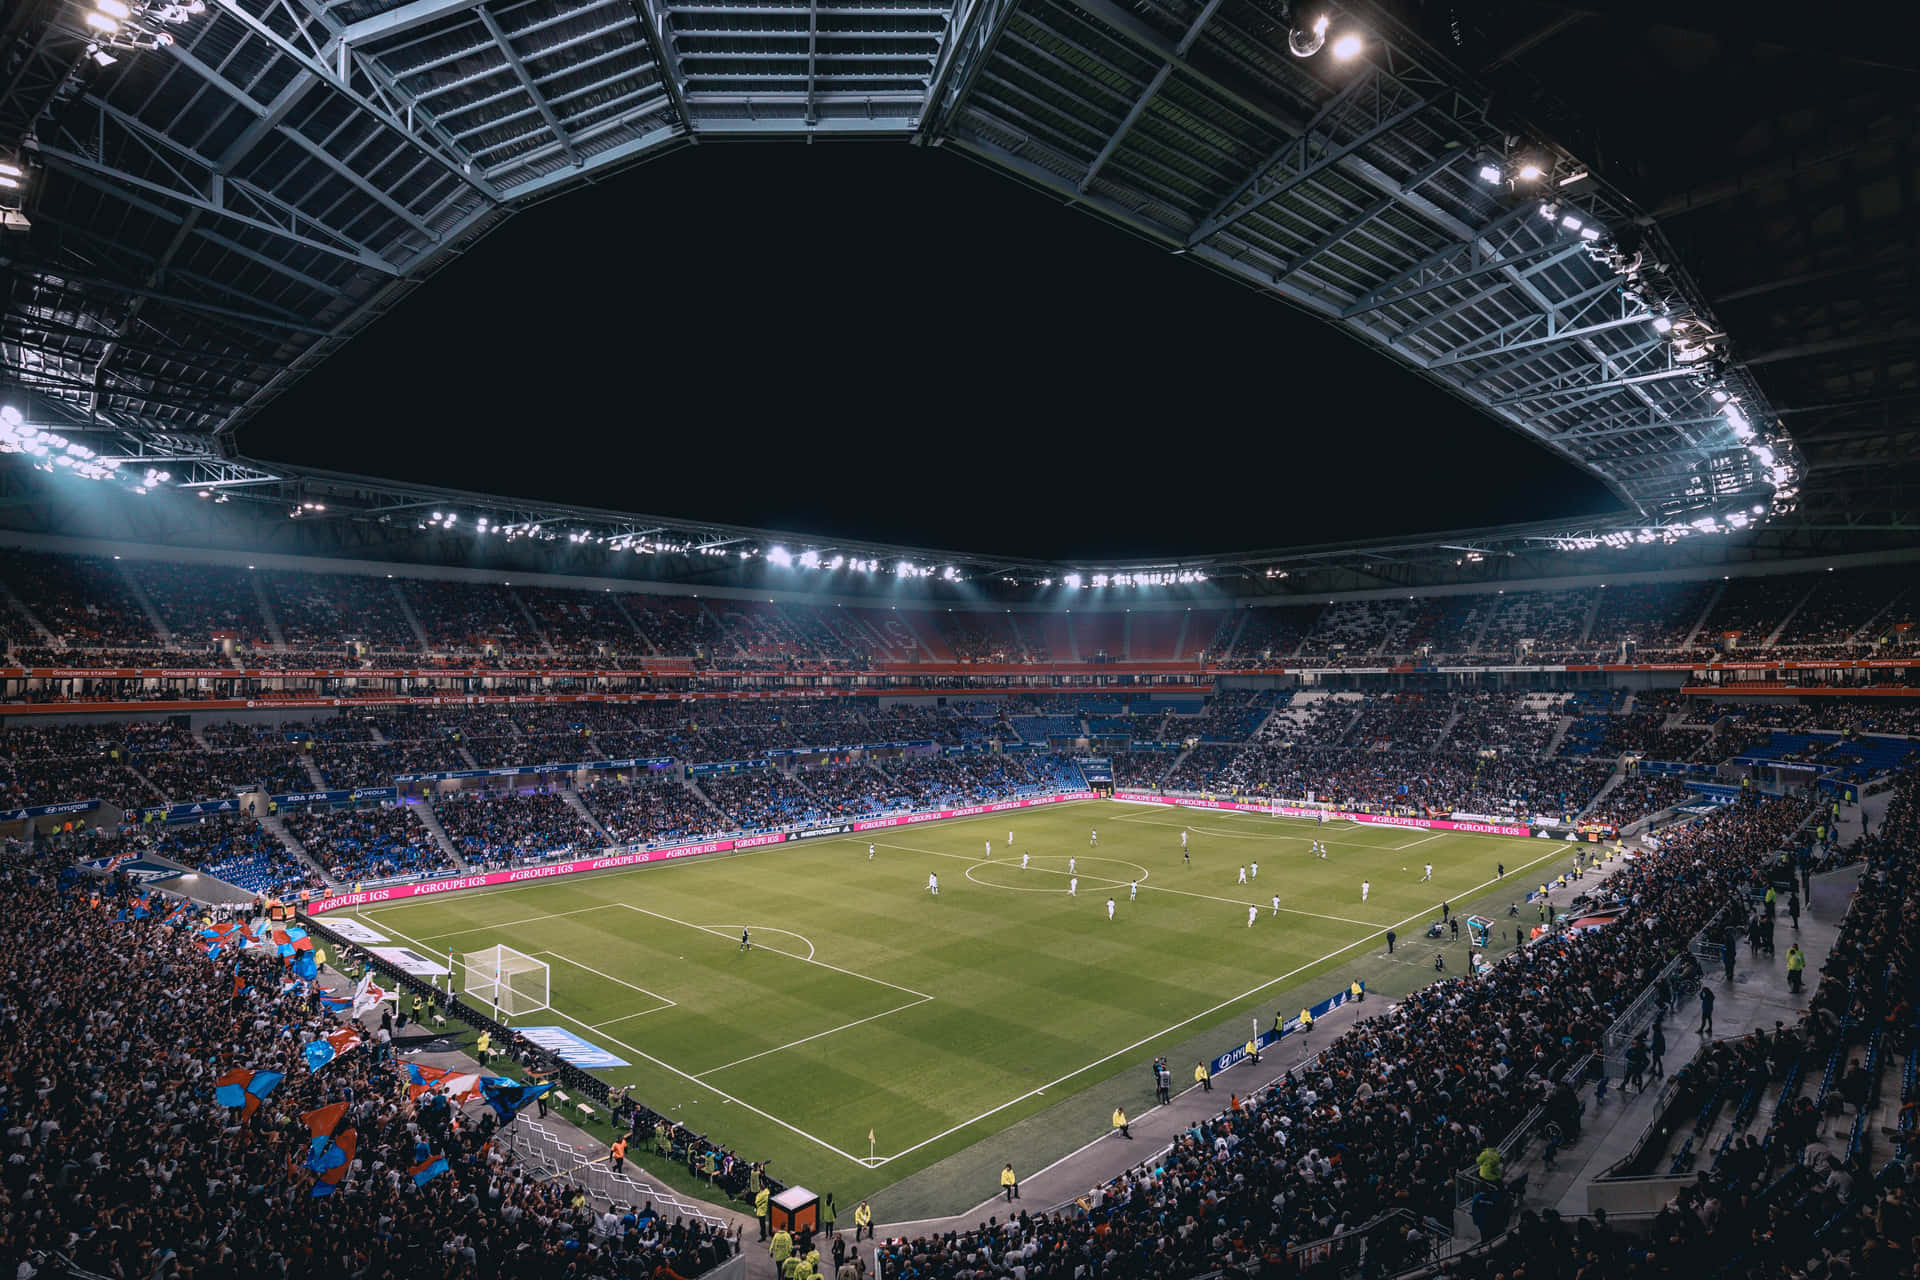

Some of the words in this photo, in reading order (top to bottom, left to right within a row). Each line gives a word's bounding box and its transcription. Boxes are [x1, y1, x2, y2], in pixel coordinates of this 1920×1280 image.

[58, 803, 89, 812] HYUNDAI
[1371, 815, 1415, 826] #GROUPE
[1415, 819, 1431, 828] IGS
[1453, 823, 1500, 834] #GROUPE
[1502, 827, 1519, 835] IGS
[666, 846, 703, 859] #GROUPE
[704, 843, 717, 853] IGS
[592, 855, 633, 870] #GROUPE
[635, 854, 649, 863] IGS
[510, 866, 556, 881] #GROUPE
[558, 864, 574, 874] IGS
[414, 879, 466, 895] #GROUPE
[468, 875, 486, 886] IGS
[318, 893, 367, 912] #GROUPE
[370, 889, 389, 901] IGS
